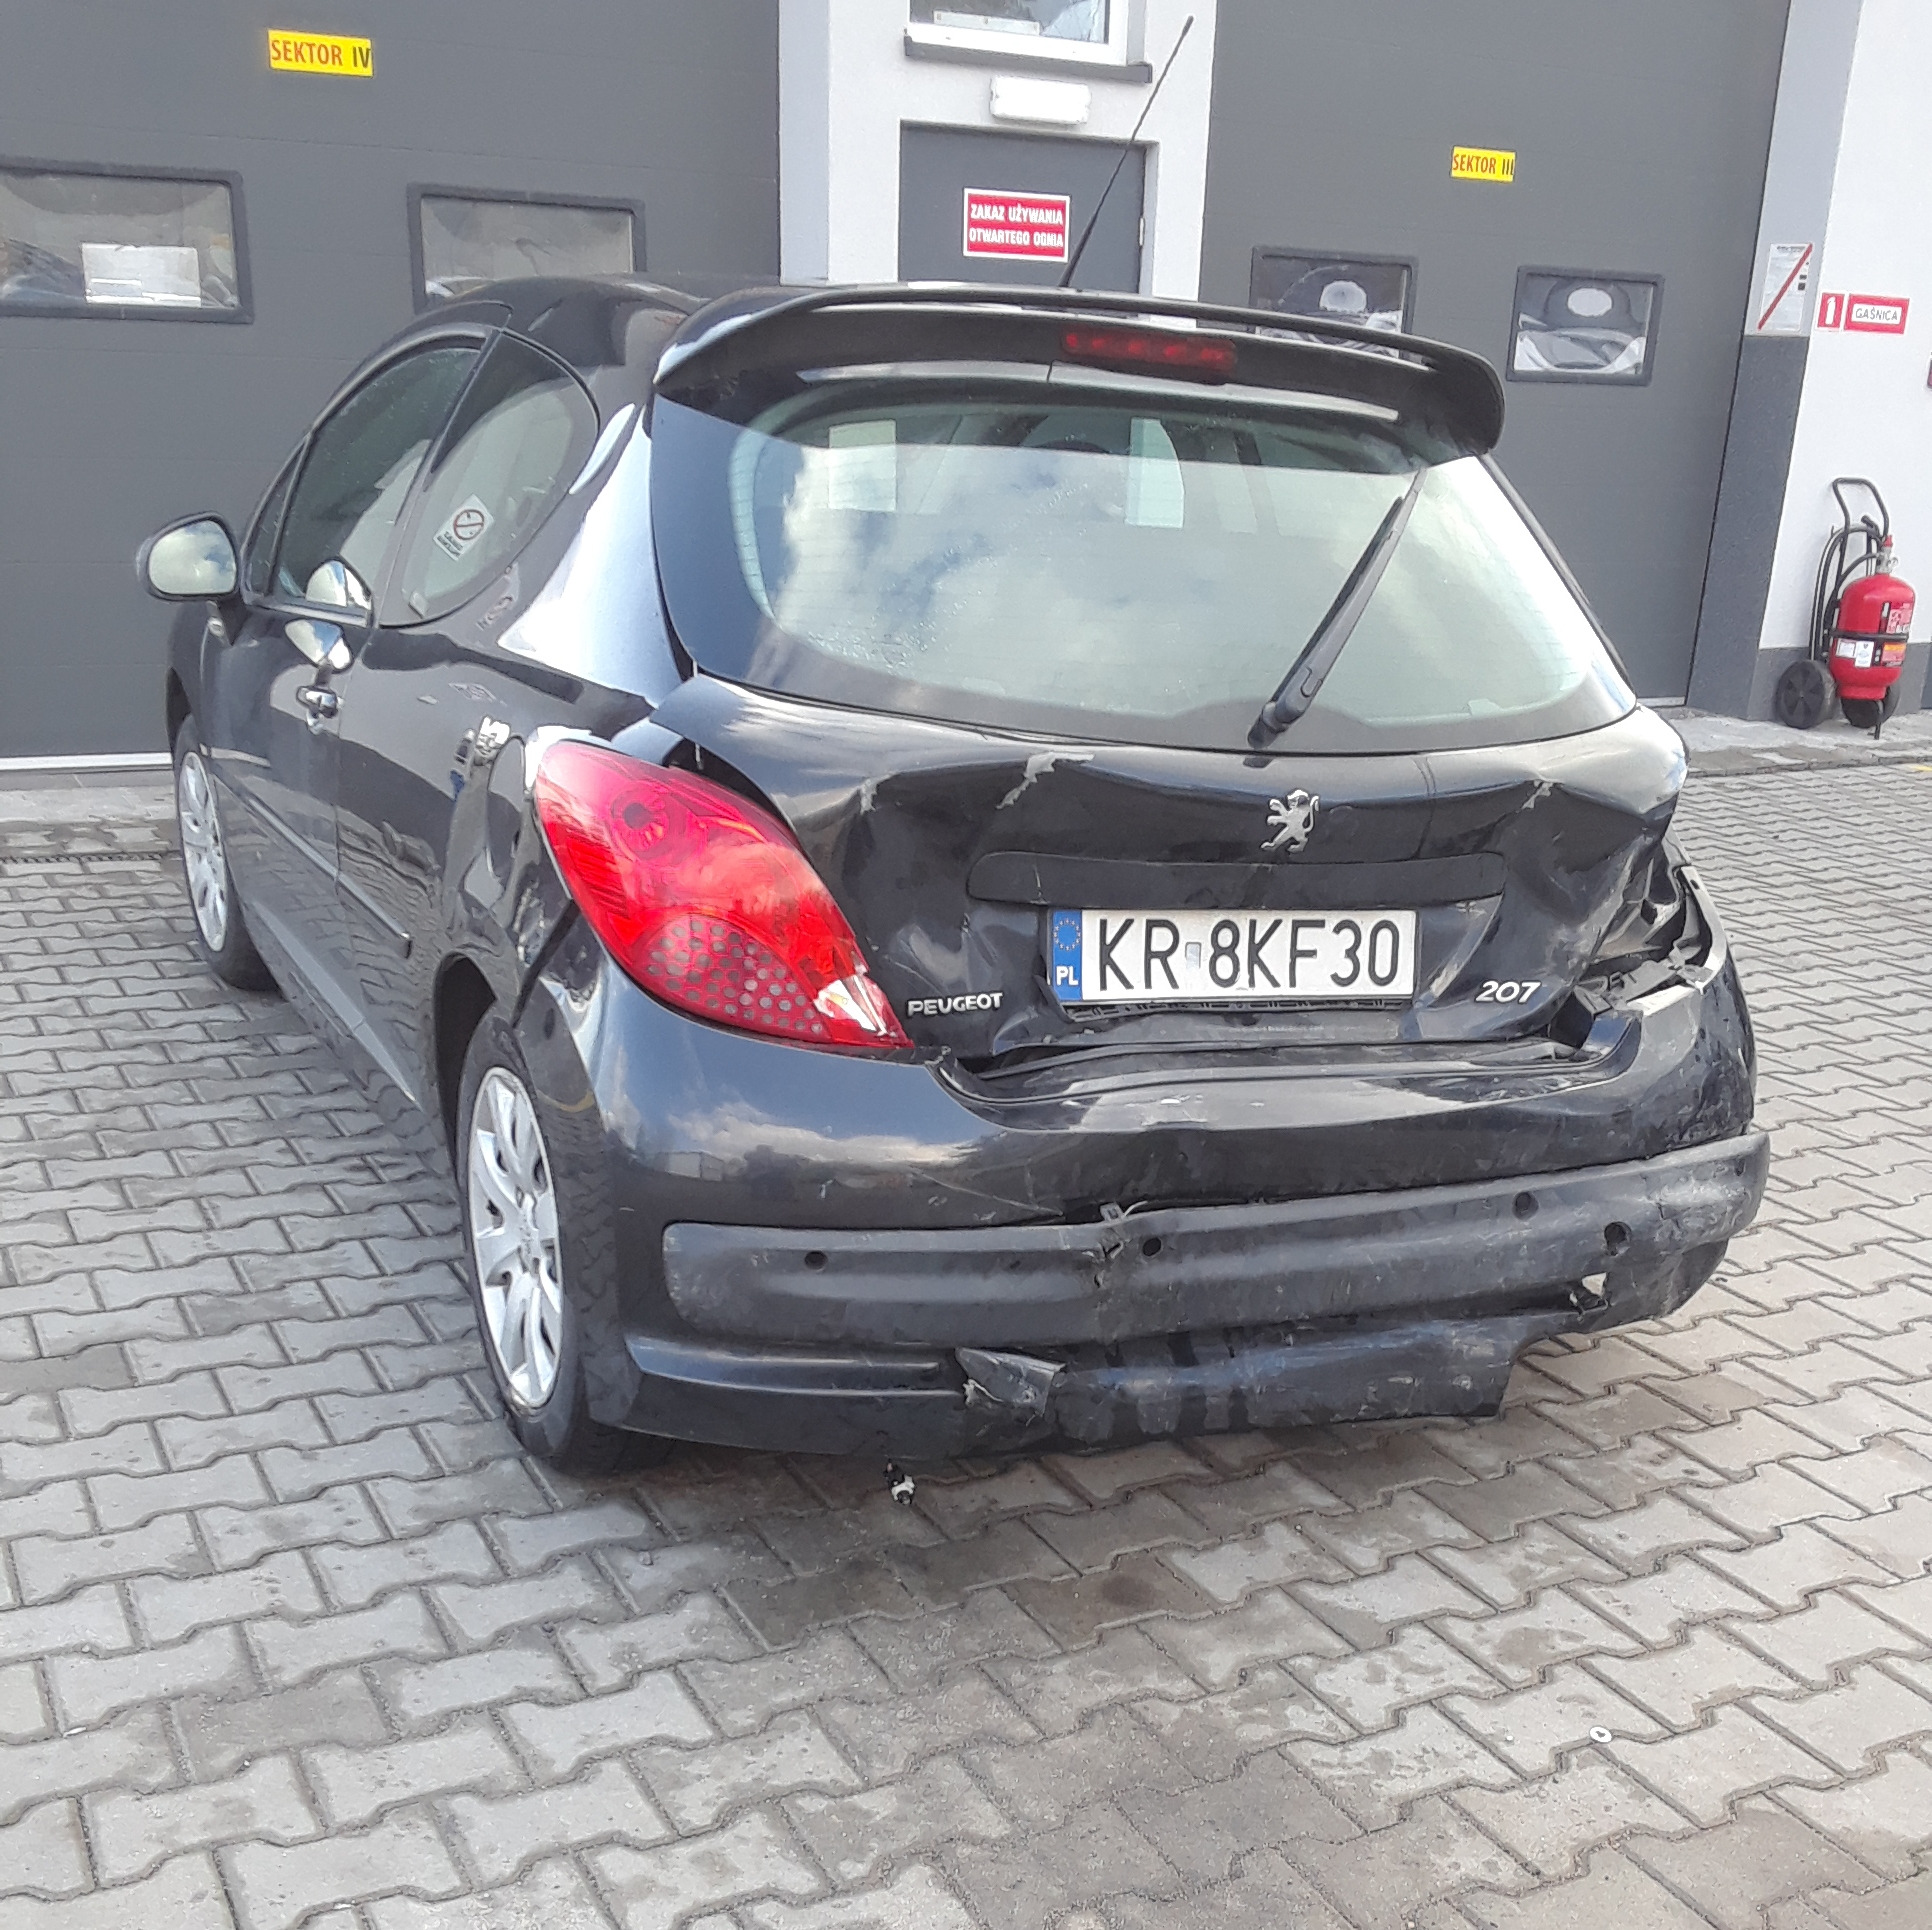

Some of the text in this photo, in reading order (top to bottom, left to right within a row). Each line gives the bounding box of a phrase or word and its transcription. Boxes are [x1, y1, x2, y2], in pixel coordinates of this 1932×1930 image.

[271, 39, 371, 69] SEKTOR IV
[1453, 153, 1514, 176] SEKTOR III
[970, 202, 1064, 225] ZAKAZ UŻYWANIA
[969, 227, 1064, 248] OTWARTEGO OGNIA
[1855, 306, 1898, 322] GAŚNICA
[1056, 918, 1400, 991] PL KR 8KF30
[1475, 980, 1542, 1004] 207
[907, 992, 1004, 1018] PEUGEOT
